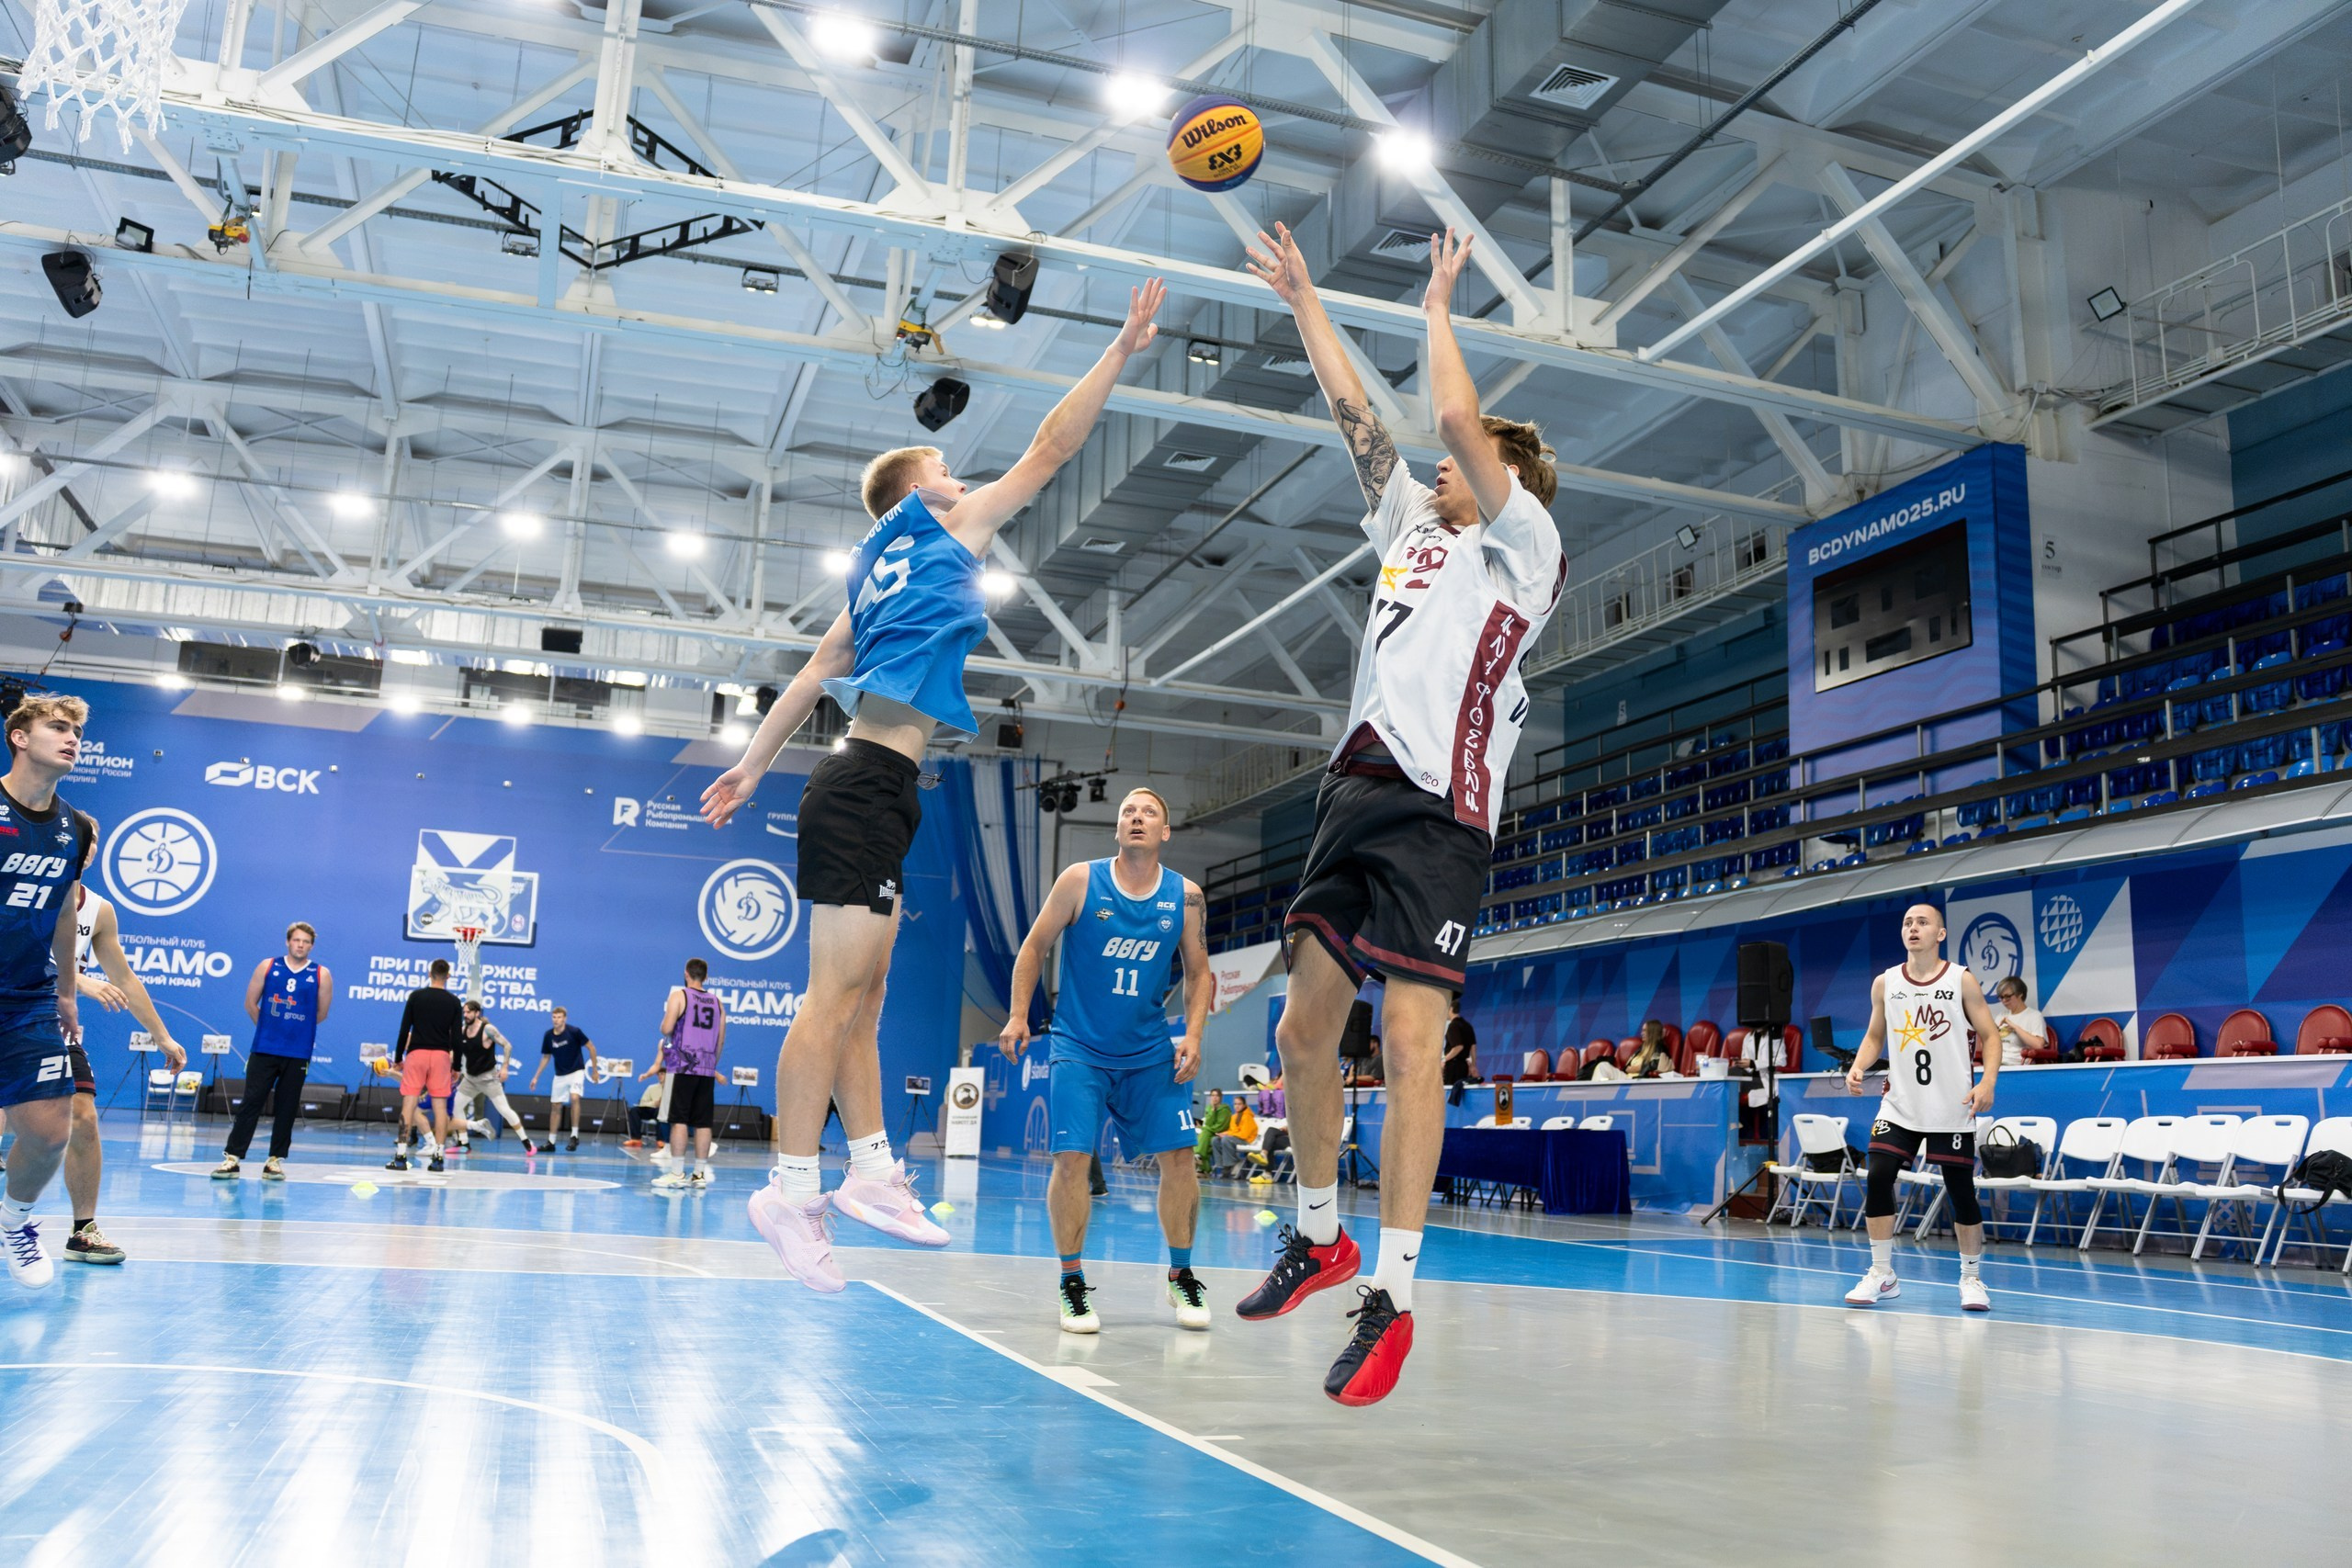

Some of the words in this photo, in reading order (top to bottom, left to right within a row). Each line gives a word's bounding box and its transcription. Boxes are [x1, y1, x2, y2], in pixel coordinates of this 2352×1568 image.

[1182, 114, 1248, 149] Wilson
[1808, 482, 1966, 566] BCDYNAMO25.RU
[2045, 540, 2055, 559] 5
[80, 740, 105, 754] 24
[74, 754, 134, 770] МПИОН
[59, 774, 96, 784] уперлига
[102, 768, 131, 778] России
[254, 765, 322, 795] ВСК
[647, 801, 681, 811] Русская
[645, 819, 688, 830] Компания
[767, 812, 797, 821] ГРУППА
[6, 882, 53, 909] 21
[119, 933, 179, 946] ЕТБОЛЬНЫЙ
[180, 938, 206, 949] КЛУБ
[1434, 919, 1466, 956] 47
[87, 944, 232, 977] НАМО
[370, 956, 410, 971] ПРИ
[414, 960, 537, 980] ПДРЖКЕ
[85, 972, 166, 986] ПРИСКИЙ
[169, 978, 201, 987] КРАЙ
[286, 978, 297, 992] 8
[368, 972, 535, 996] ПРАВИЕЛСТВА
[704, 977, 767, 987] ЛЕЙБОЛЬНЫЙ
[769, 981, 791, 990] КЛУБ
[1112, 967, 1139, 997] 11
[500, 998, 551, 1012] КРАЯ
[284, 1011, 306, 1021] group
[693, 1004, 715, 1030] 13
[726, 1015, 761, 1025] РСКИЙ
[763, 1018, 791, 1027] КРАЙ
[37, 1055, 73, 1082] 21
[1915, 1049, 1932, 1086] 8
[1178, 1110, 1195, 1131] 11
[1951, 1134, 1962, 1150] 8
